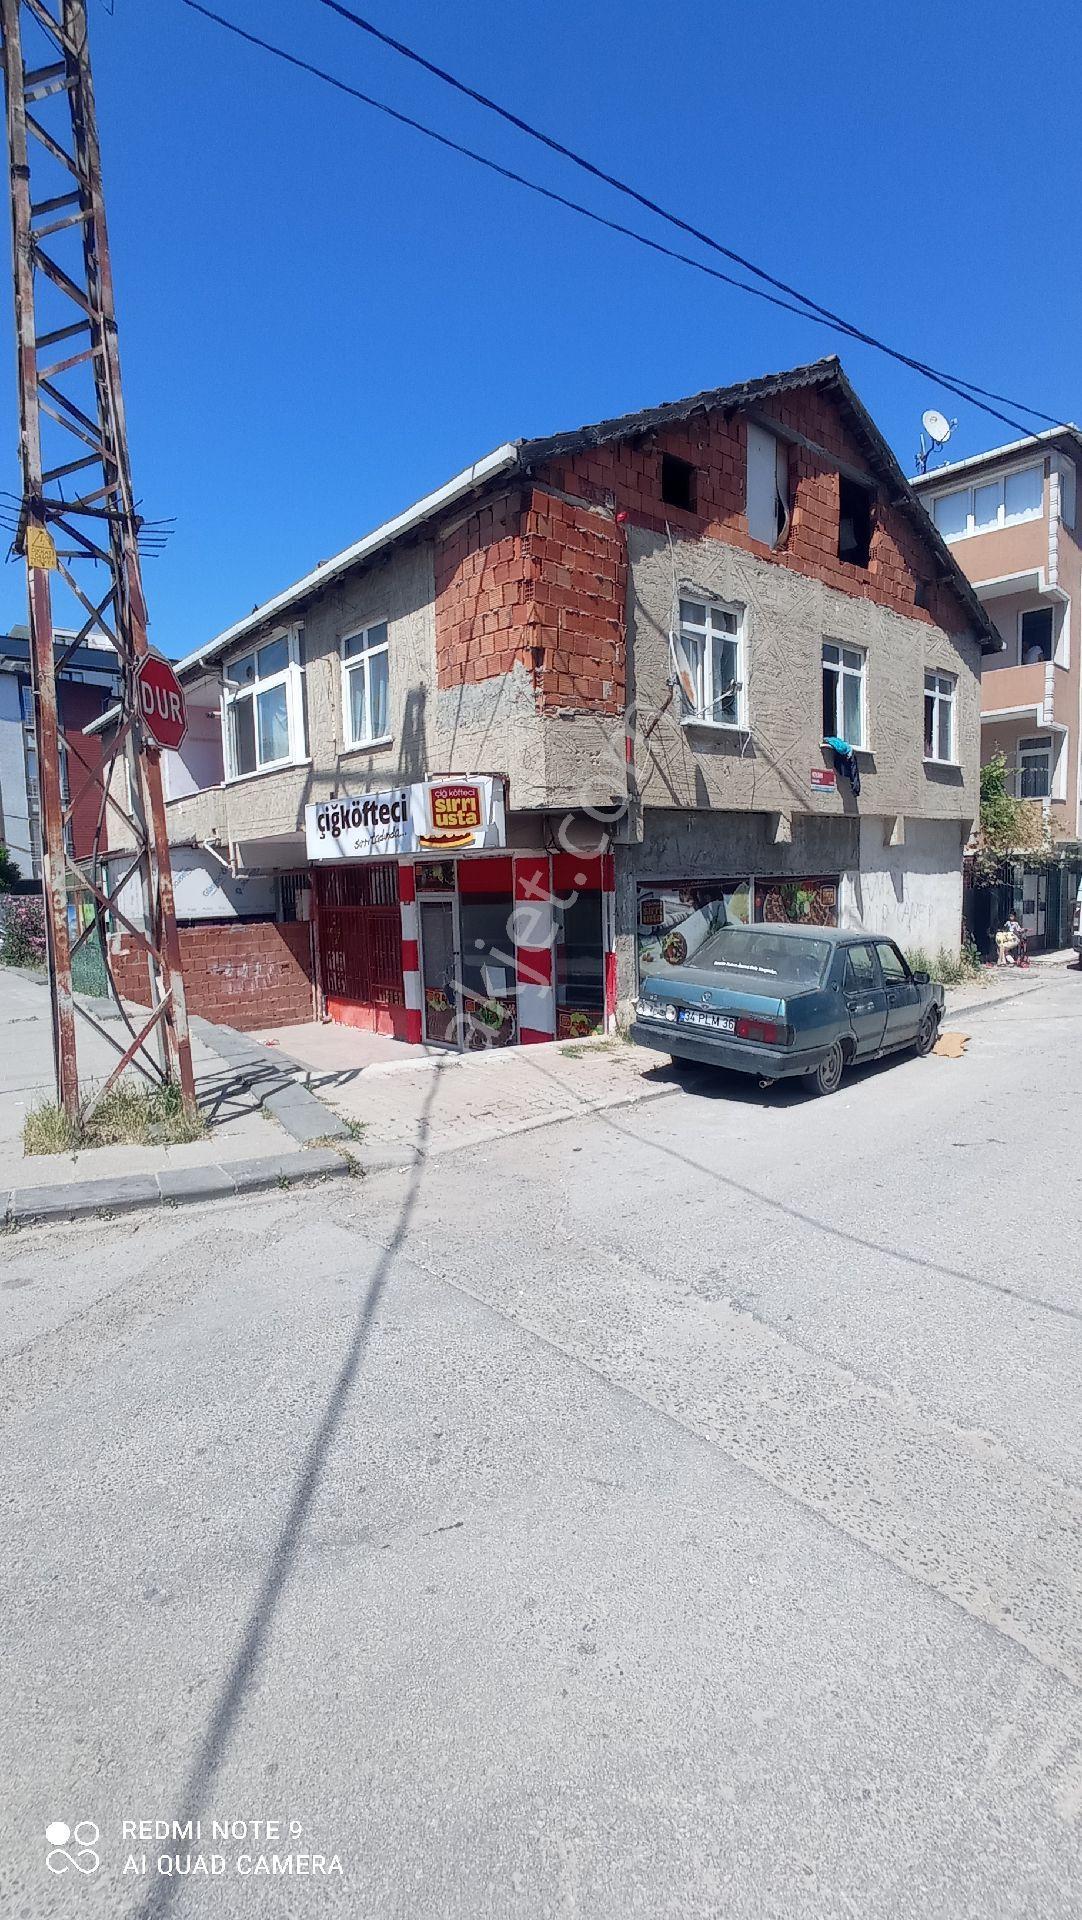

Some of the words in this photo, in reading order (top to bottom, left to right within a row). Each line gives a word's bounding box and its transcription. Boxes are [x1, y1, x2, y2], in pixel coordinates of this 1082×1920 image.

[141, 680, 183, 724] DUR
[448, 788, 475, 797] köfteci
[435, 797, 476, 813] sırrı
[317, 794, 408, 839] çiğköfteci
[436, 810, 477, 826] usta
[684, 1010, 696, 1022] 34
[699, 1013, 720, 1026] PLM
[722, 1019, 734, 1030] 36
